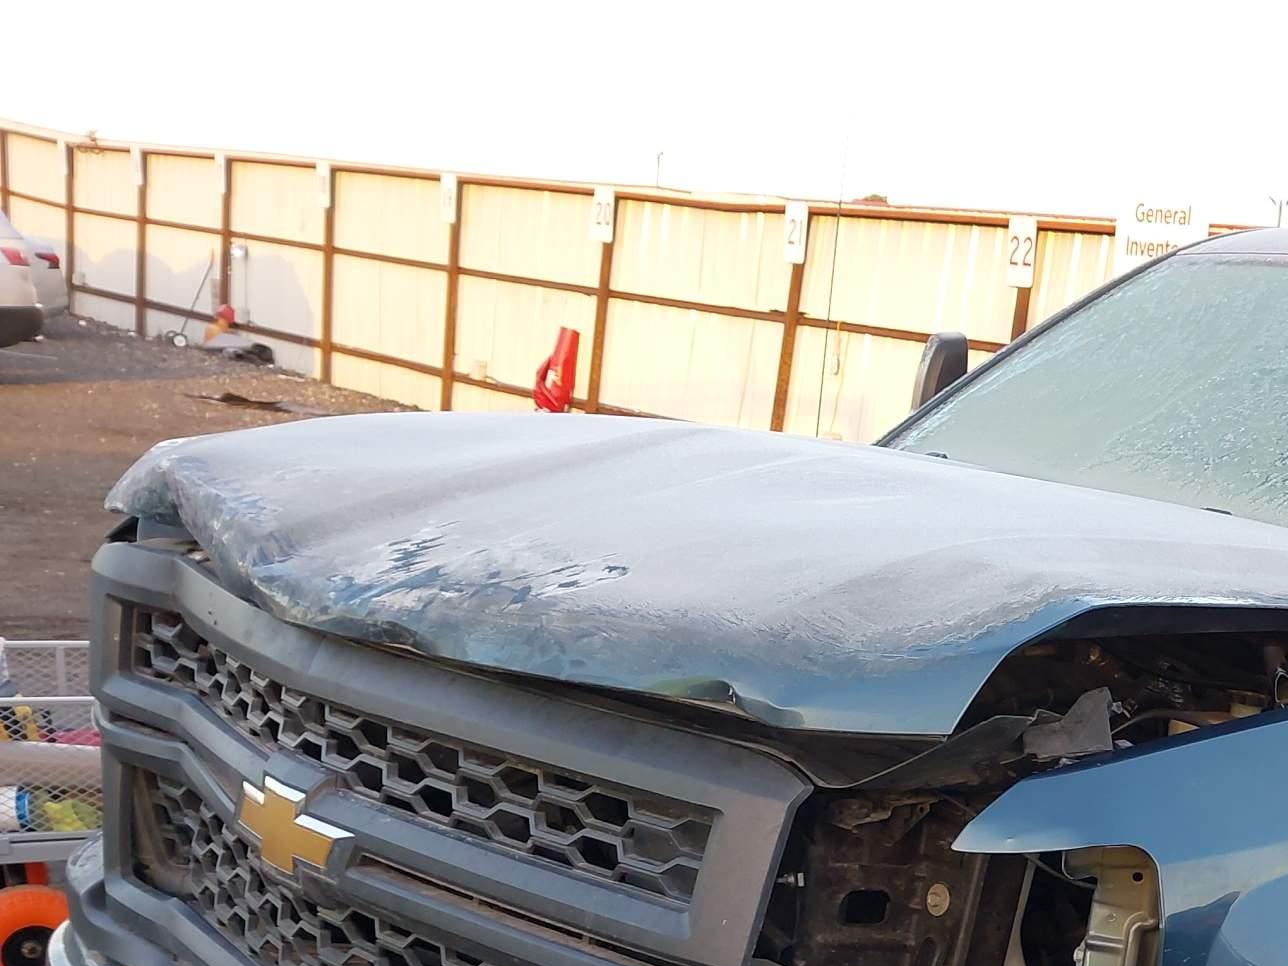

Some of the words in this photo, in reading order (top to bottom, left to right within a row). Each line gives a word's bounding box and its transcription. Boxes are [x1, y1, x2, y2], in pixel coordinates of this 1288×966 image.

[595, 201, 611, 226] 20
[1135, 203, 1192, 225] General
[786, 218, 804, 246] 21
[1009, 235, 1034, 267] 22
